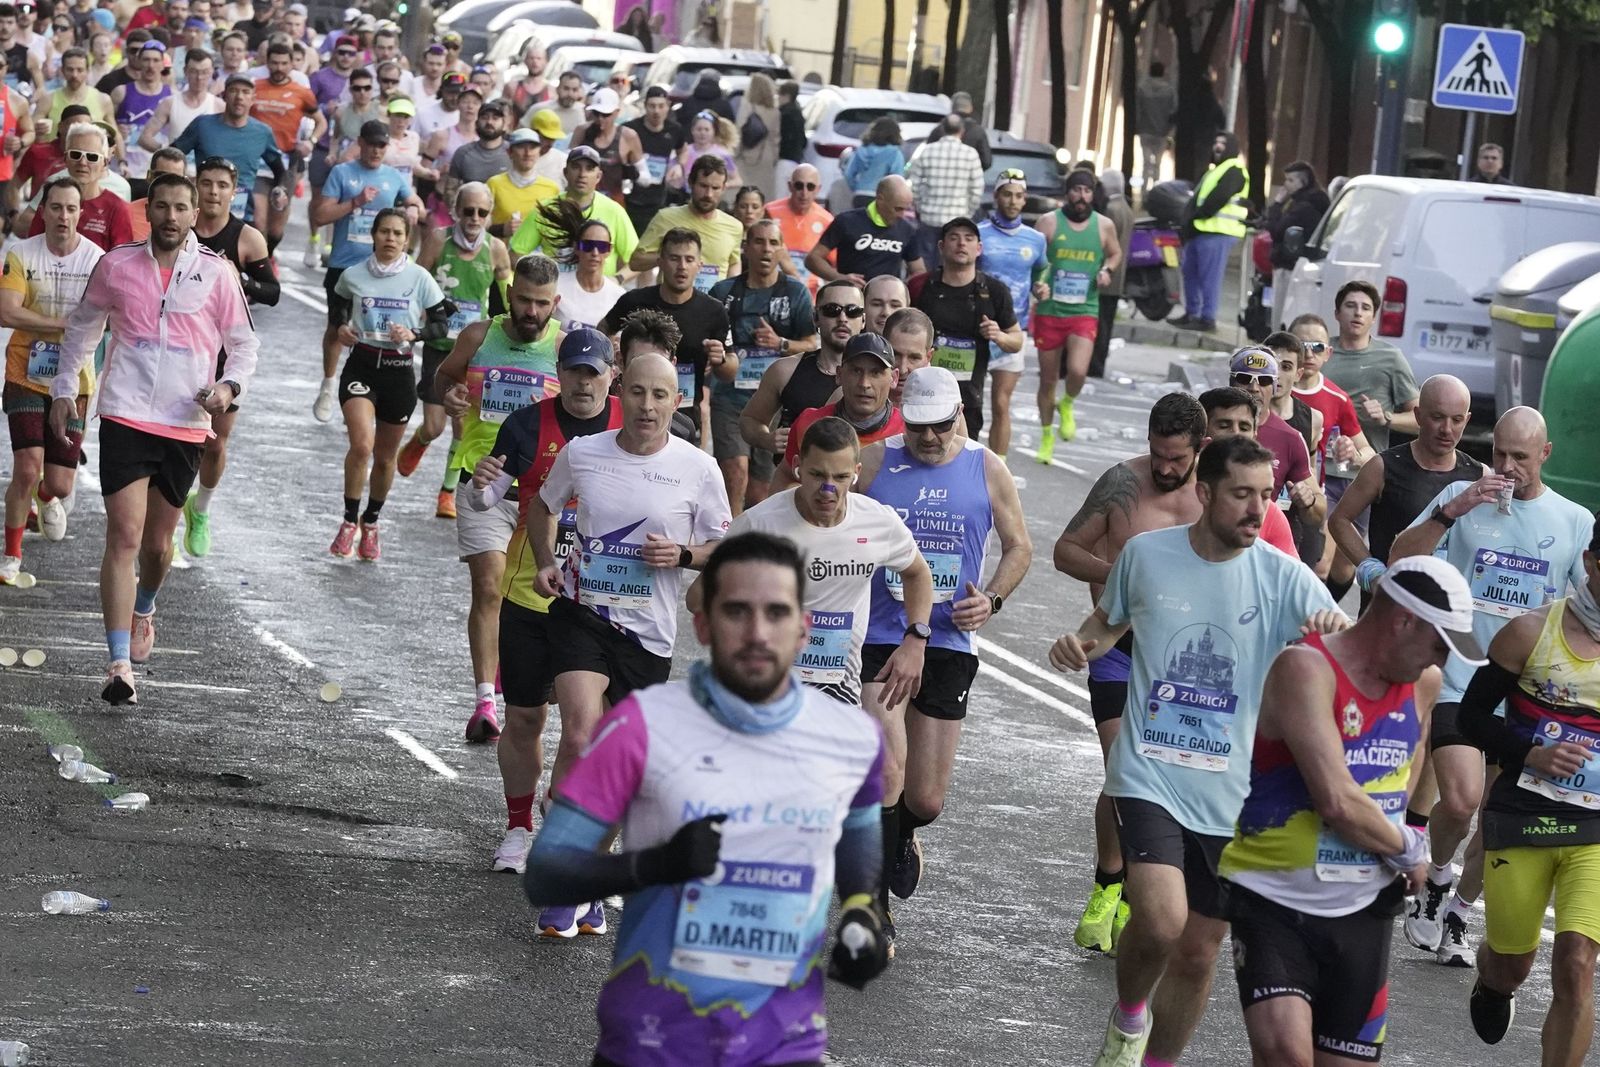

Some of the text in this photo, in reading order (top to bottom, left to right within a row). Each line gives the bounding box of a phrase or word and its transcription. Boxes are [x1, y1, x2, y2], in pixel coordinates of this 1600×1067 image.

[871, 238, 904, 253] asics
[1429, 335, 1462, 349] 9177
[1246, 355, 1267, 368] Buff
[503, 388, 522, 399] 6813
[482, 399, 515, 412] MALEN
[915, 507, 948, 518] vinos
[915, 519, 965, 533] JUMILLA
[607, 565, 628, 575] 9371
[1501, 557, 1541, 571] ZURICH
[579, 577, 653, 595] MIGUEL ANGEL
[1498, 575, 1520, 586] 5929
[1482, 585, 1530, 606] JULIAN
[801, 653, 846, 667] MANUEL
[1180, 691, 1228, 708] ZURICH
[1179, 714, 1203, 728] 7651
[1143, 729, 1231, 754] GUILLE GANDO
[1522, 825, 1577, 835] HANKER
[1317, 849, 1357, 862] FRANK
[730, 866, 802, 888] ZURICH
[729, 901, 768, 920] 7845
[685, 920, 799, 954] D.MARTIN
[1318, 1034, 1378, 1057] PALACIEGO
